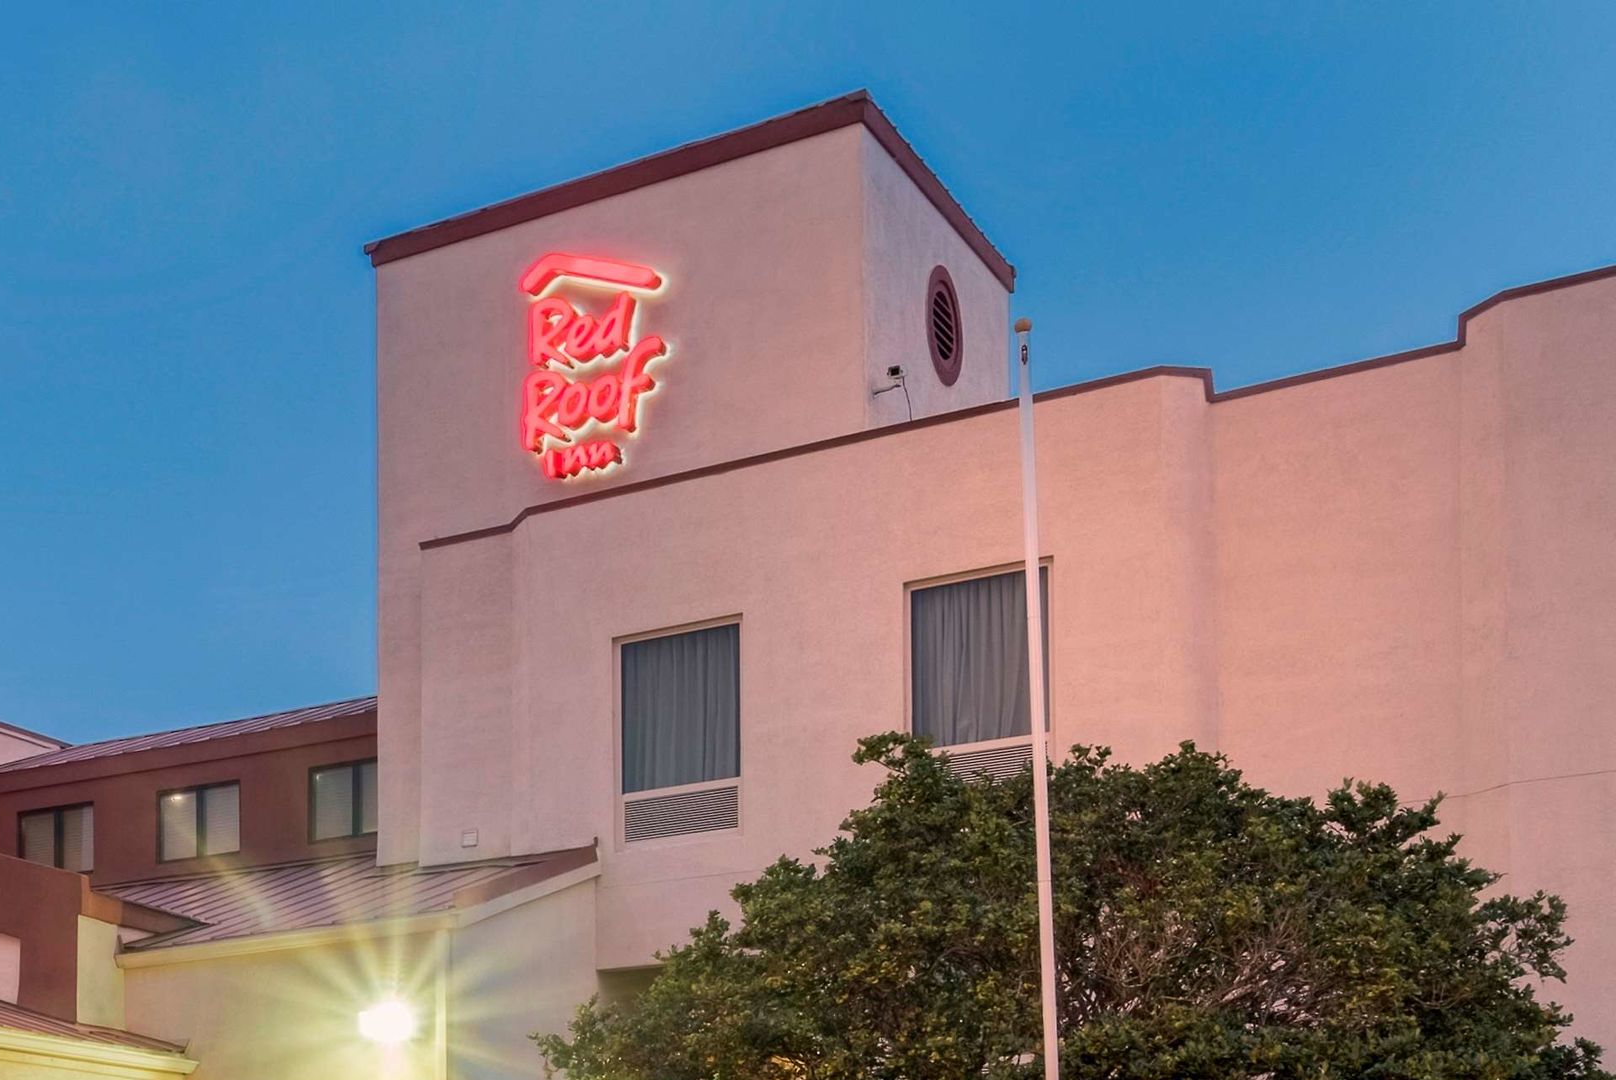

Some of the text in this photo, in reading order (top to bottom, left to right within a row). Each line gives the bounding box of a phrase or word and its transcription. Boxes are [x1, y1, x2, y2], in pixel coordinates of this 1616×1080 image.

[529, 292, 637, 370] Red
[521, 336, 668, 455] Roof
[543, 441, 624, 481] Inn
